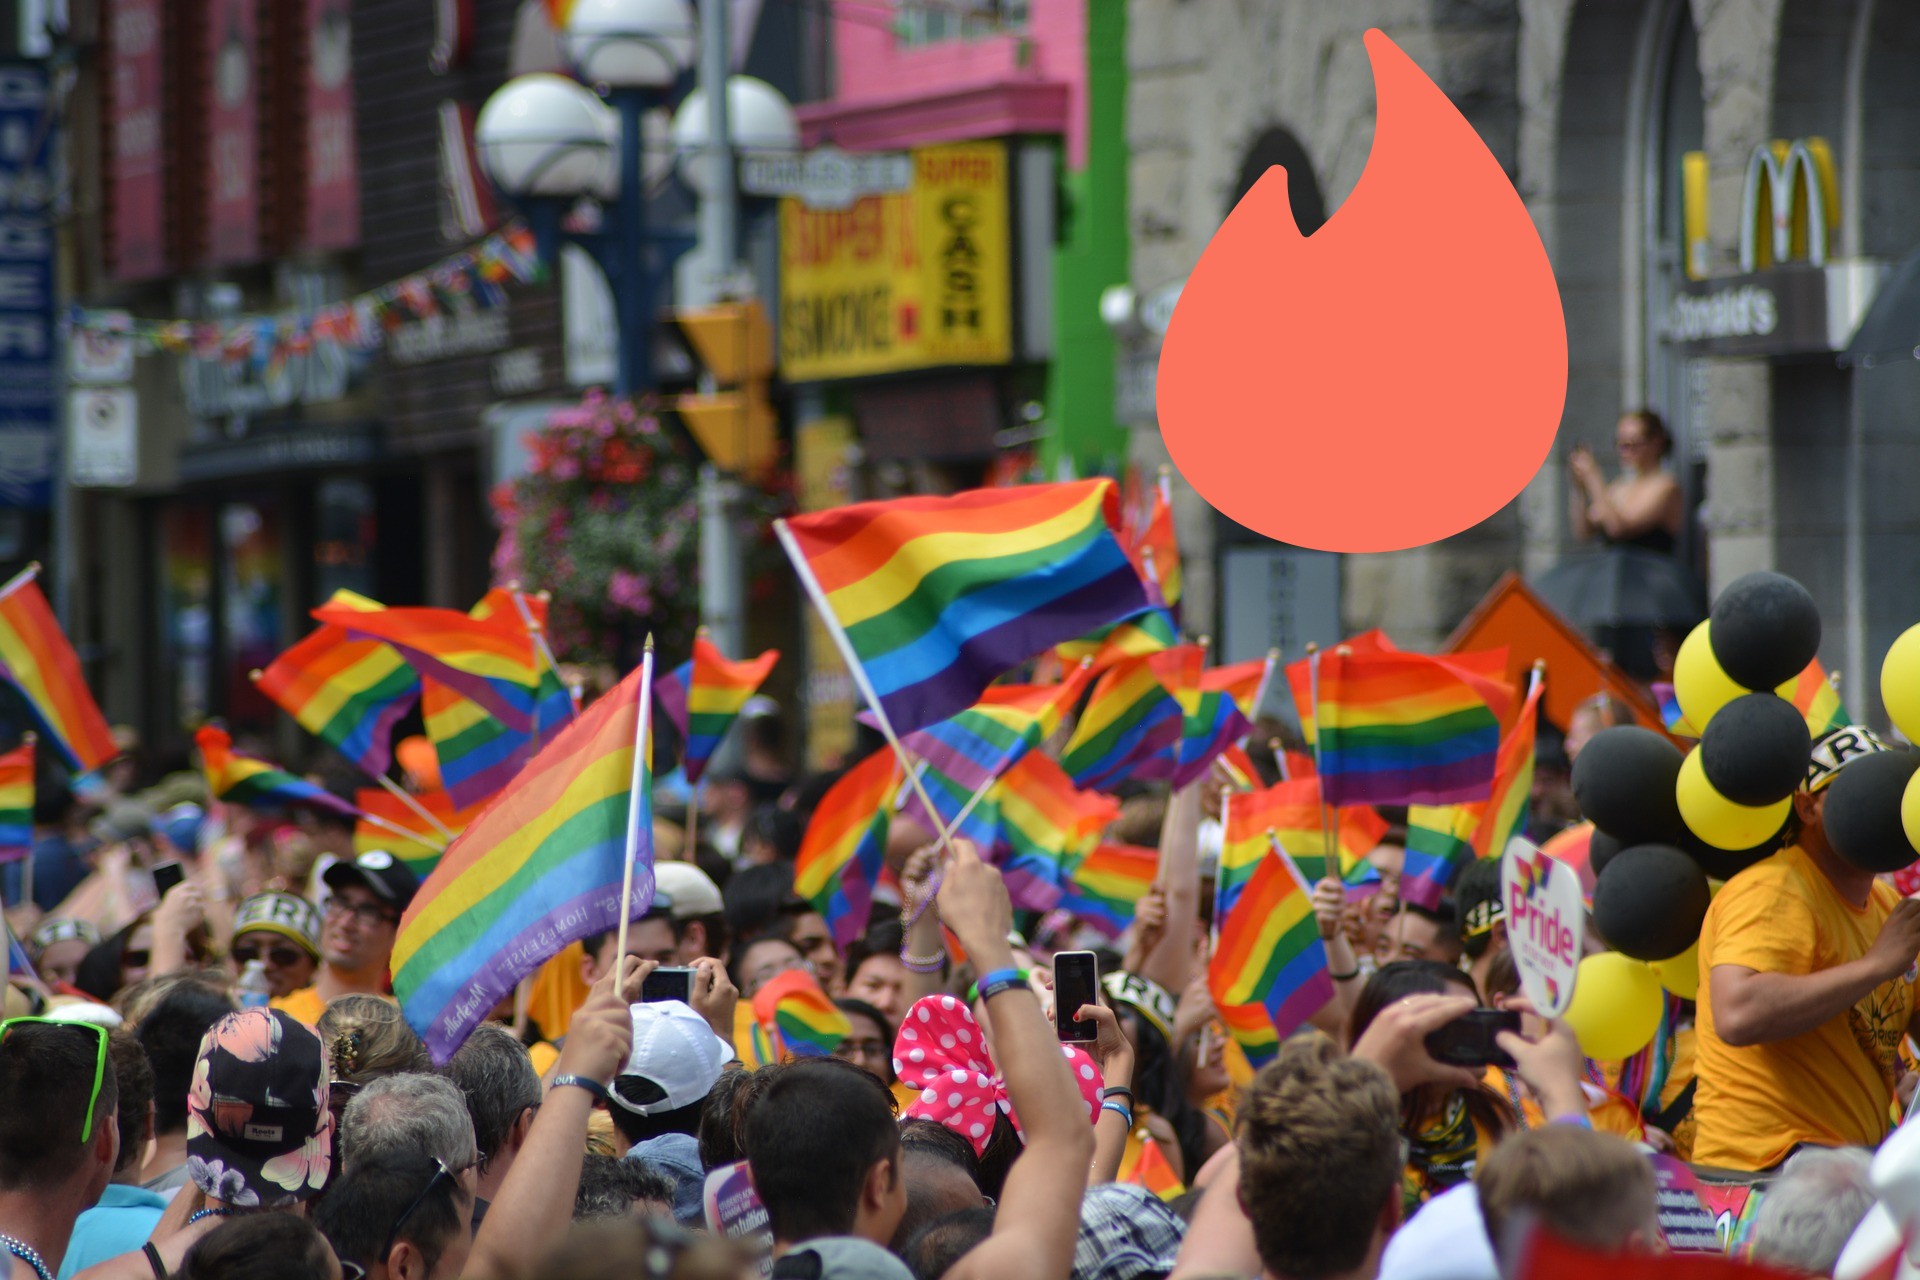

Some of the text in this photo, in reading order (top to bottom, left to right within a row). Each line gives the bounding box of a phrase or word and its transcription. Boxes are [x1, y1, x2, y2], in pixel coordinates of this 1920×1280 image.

[940, 196, 981, 335] CASH
[1510, 881, 1574, 968] Pride
[739, 1207, 769, 1236] tuition
